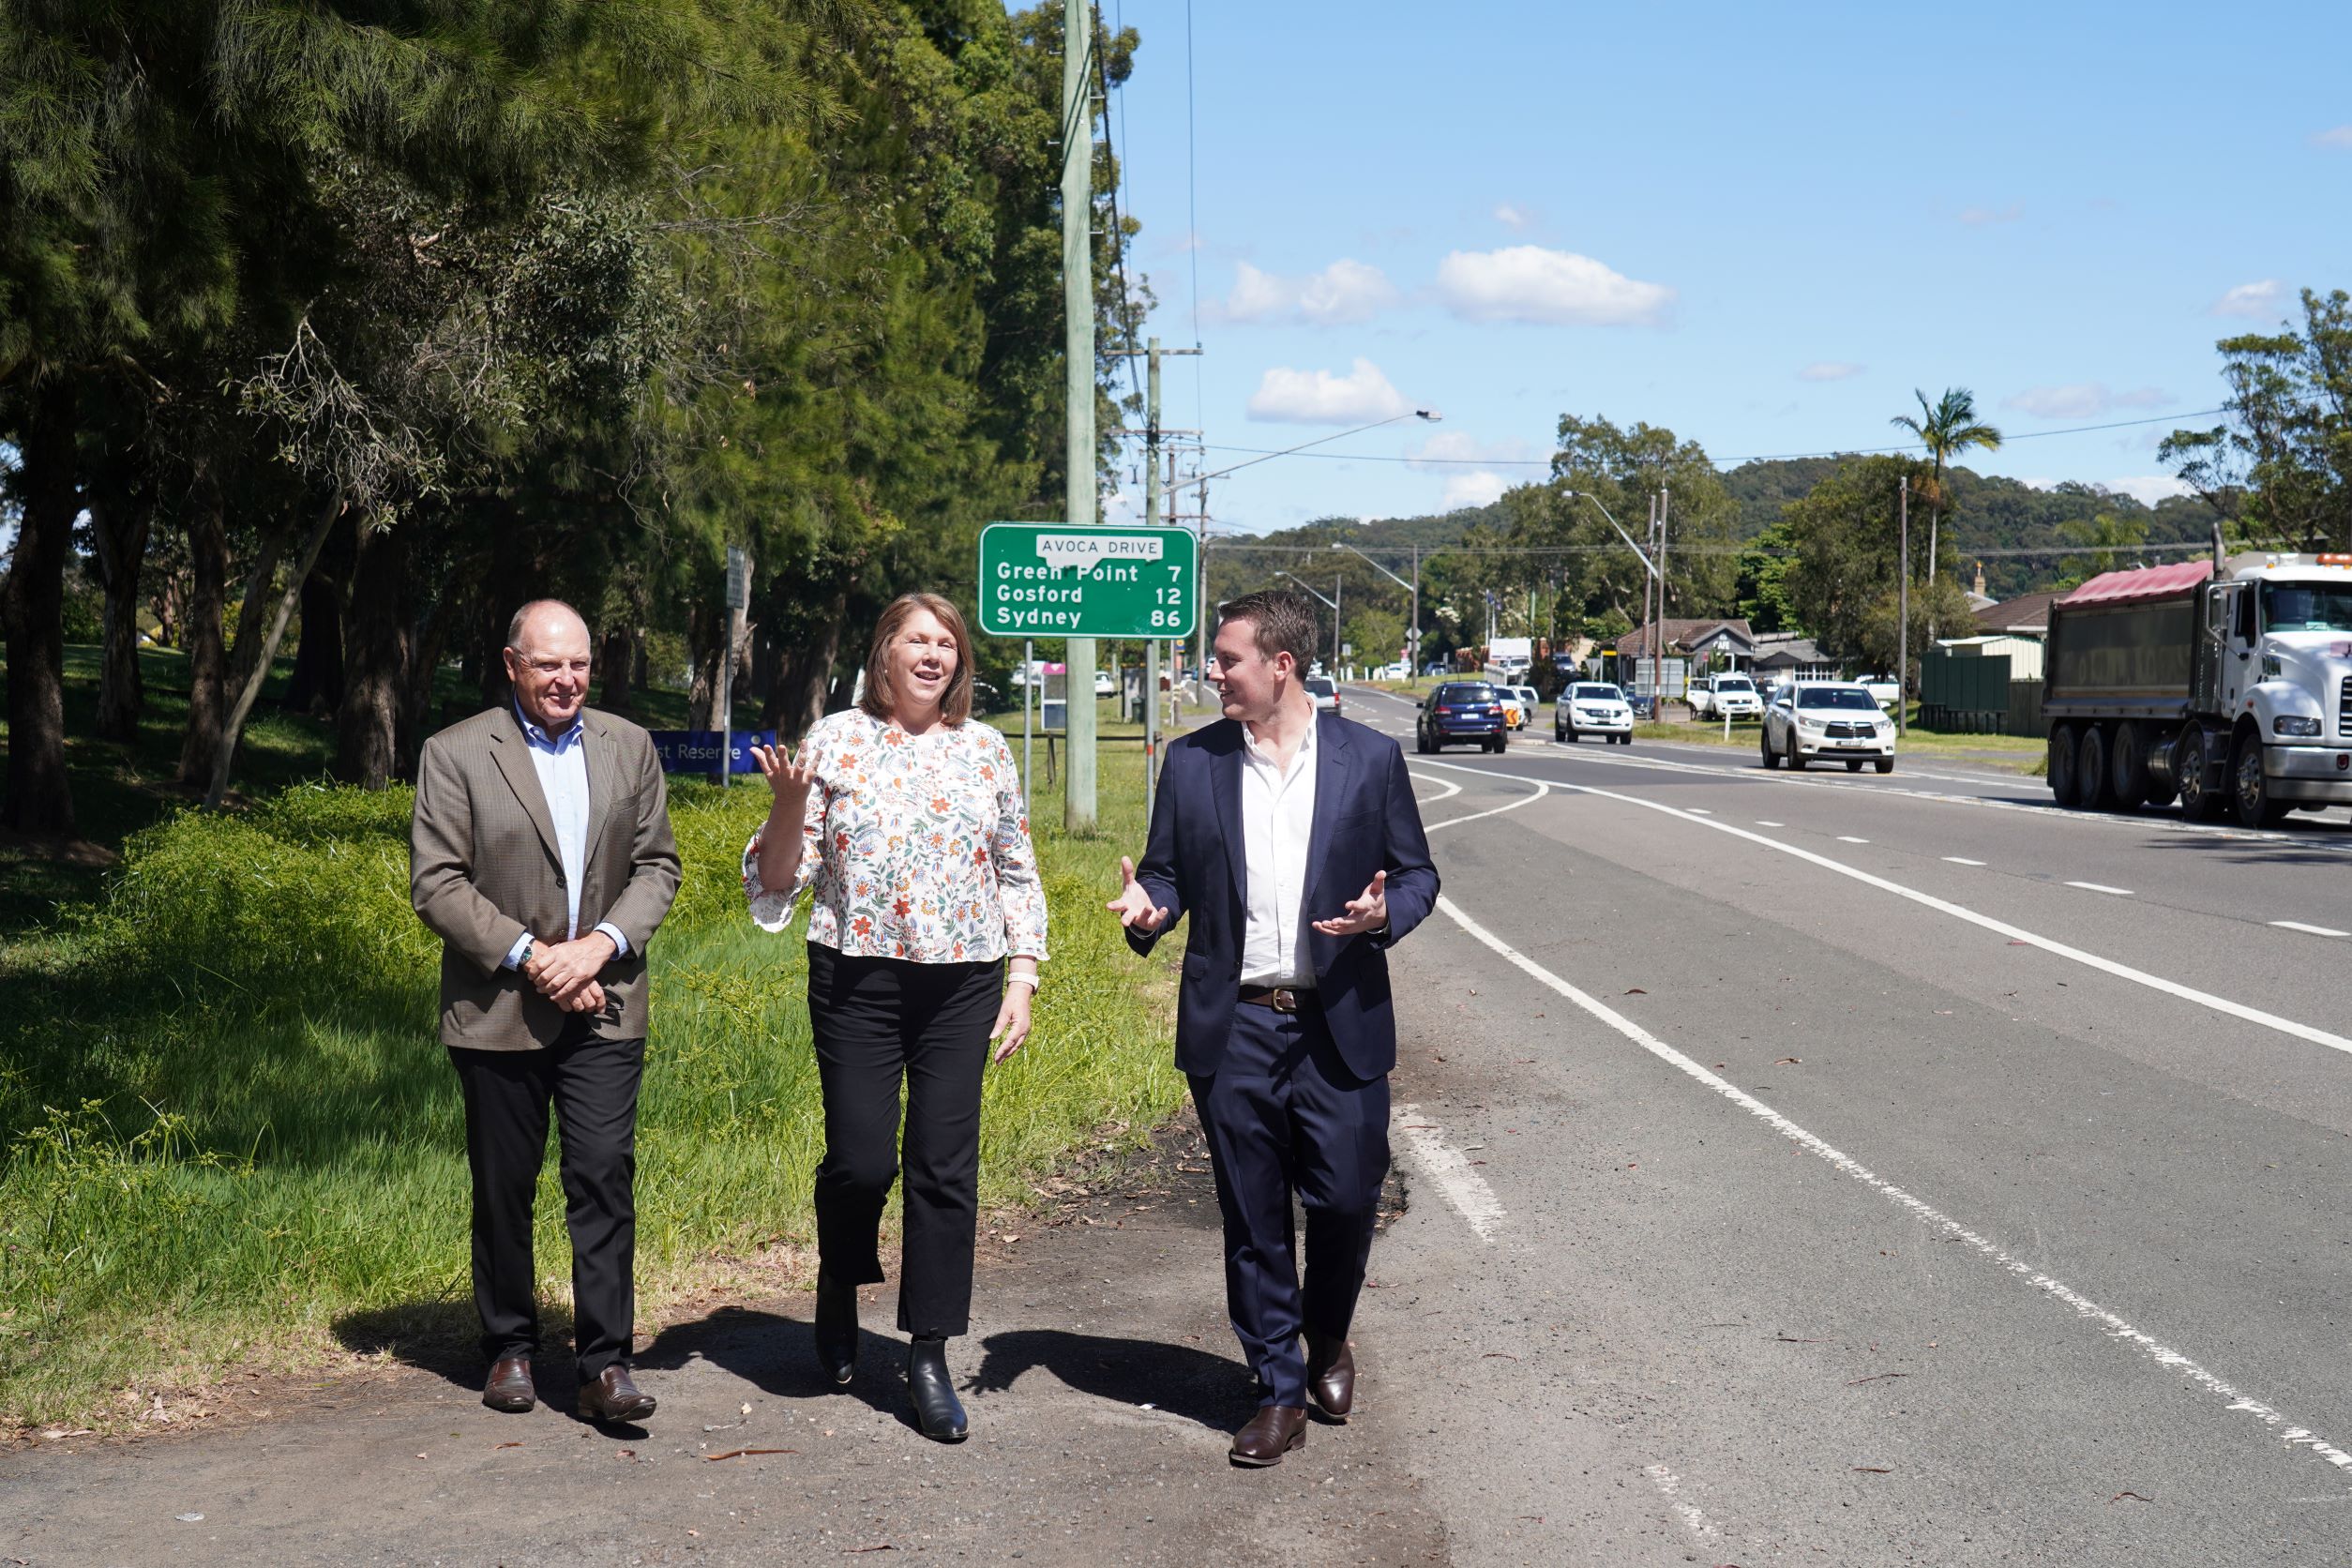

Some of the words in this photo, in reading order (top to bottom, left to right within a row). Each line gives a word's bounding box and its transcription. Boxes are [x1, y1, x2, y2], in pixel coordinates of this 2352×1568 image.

[1042, 540, 1098, 553] AVOCA
[1108, 541, 1158, 554] DRIVE
[997, 562, 1063, 580] Green
[1077, 564, 1138, 581] Point
[1168, 565, 1182, 582] 7
[997, 584, 1082, 603] Gosford
[1155, 588, 1182, 605] 12
[997, 607, 1081, 629] Sydney
[1151, 610, 1182, 627] 86
[678, 744, 741, 760] Resere
